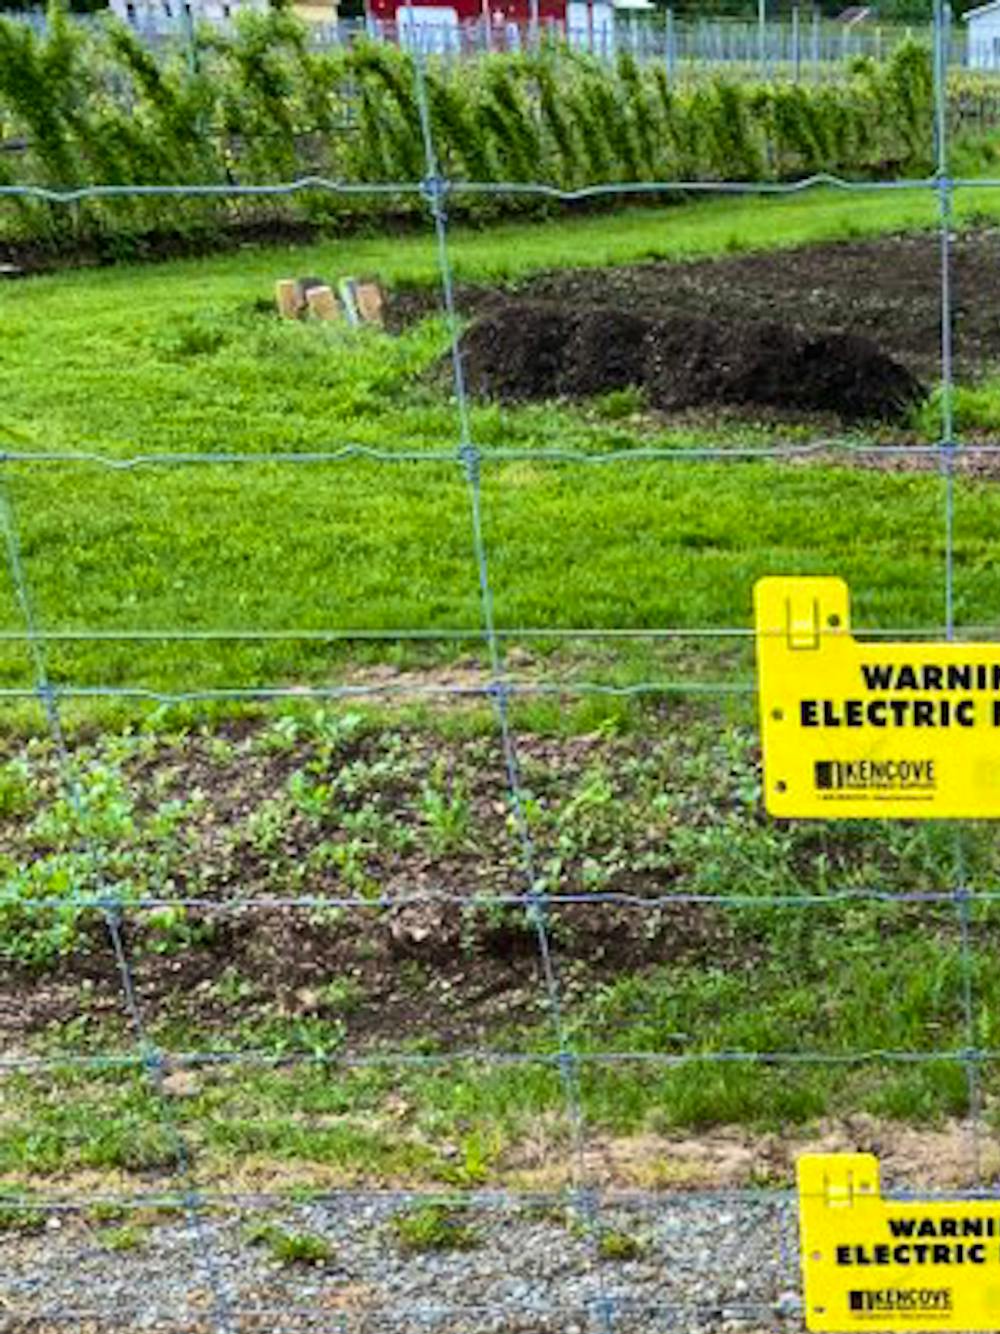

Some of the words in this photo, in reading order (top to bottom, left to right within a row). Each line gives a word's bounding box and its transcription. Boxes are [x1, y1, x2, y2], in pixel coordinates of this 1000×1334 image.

[800, 700, 974, 727] ELECTRIC
[846, 760, 934, 780] KENCOVE
[836, 1244, 986, 1266] ELECTRIC
